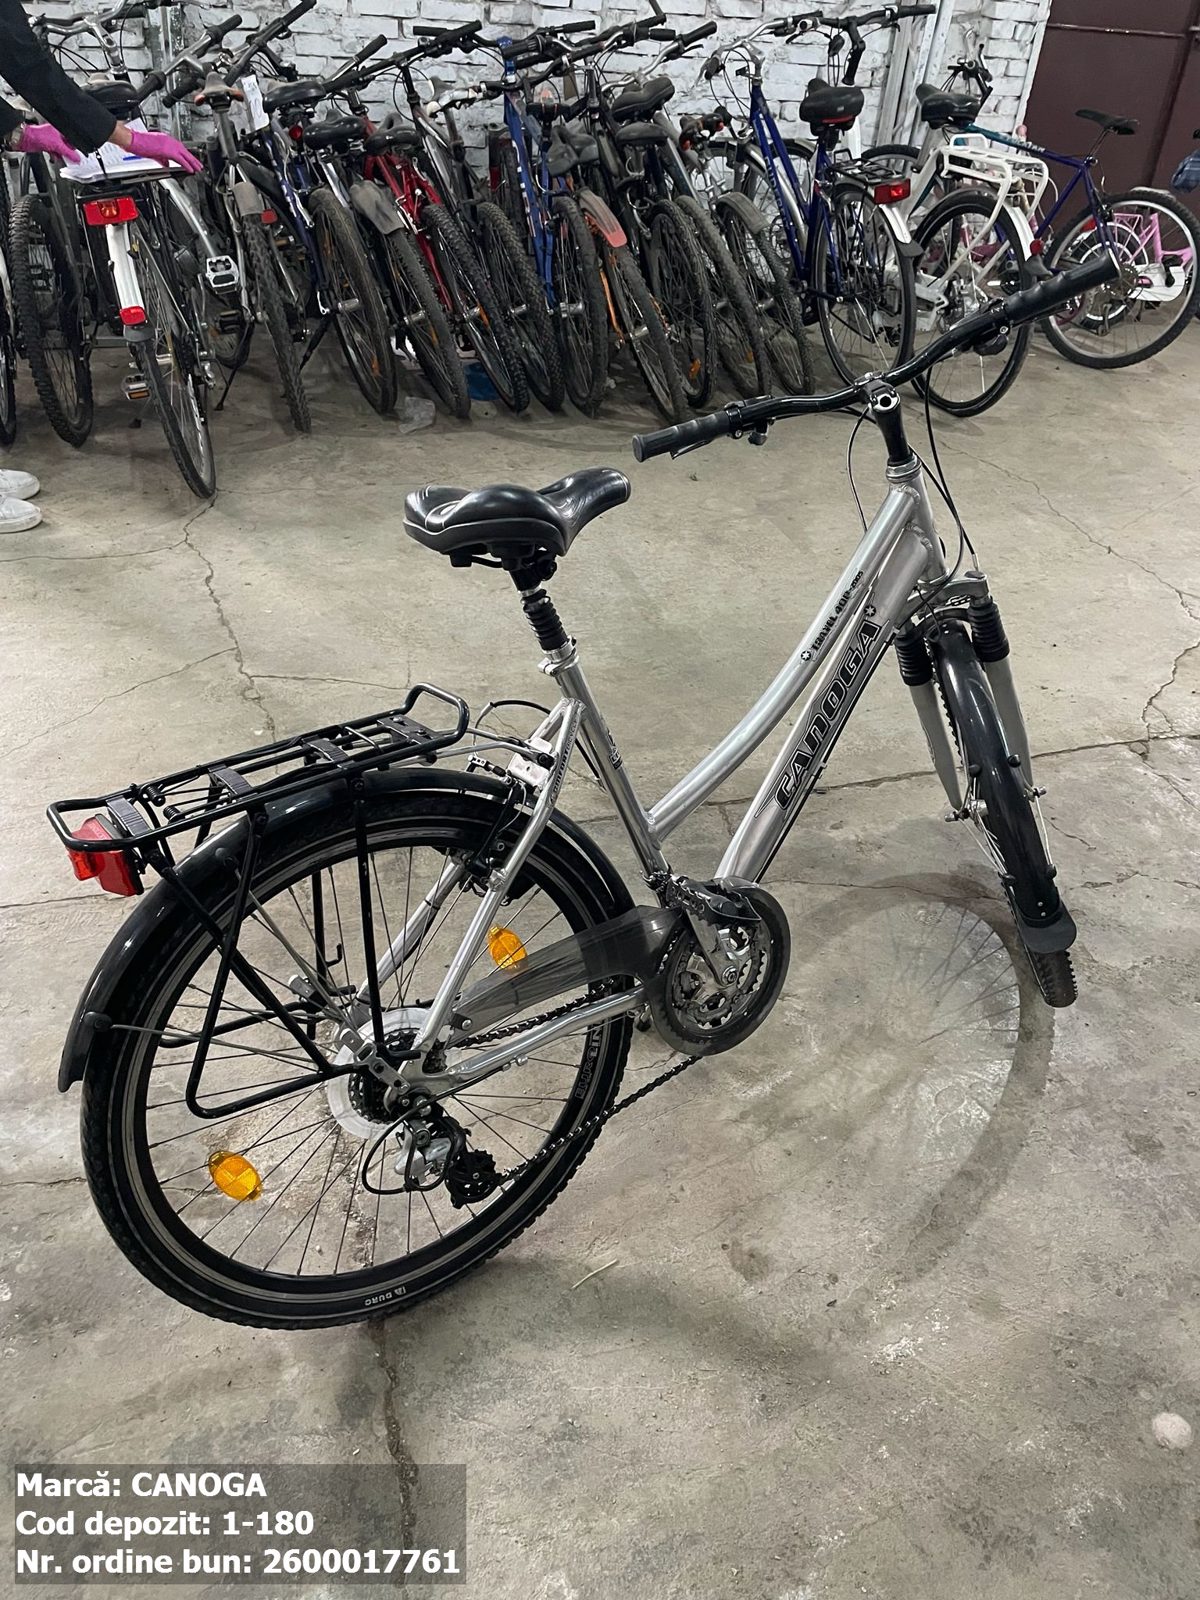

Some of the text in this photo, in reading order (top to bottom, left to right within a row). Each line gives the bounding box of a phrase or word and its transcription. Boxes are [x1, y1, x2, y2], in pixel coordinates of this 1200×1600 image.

[811, 615, 838, 651] TRAVEL
[775, 620, 882, 809] CANOGA
[364, 1291, 393, 1306] DURO
